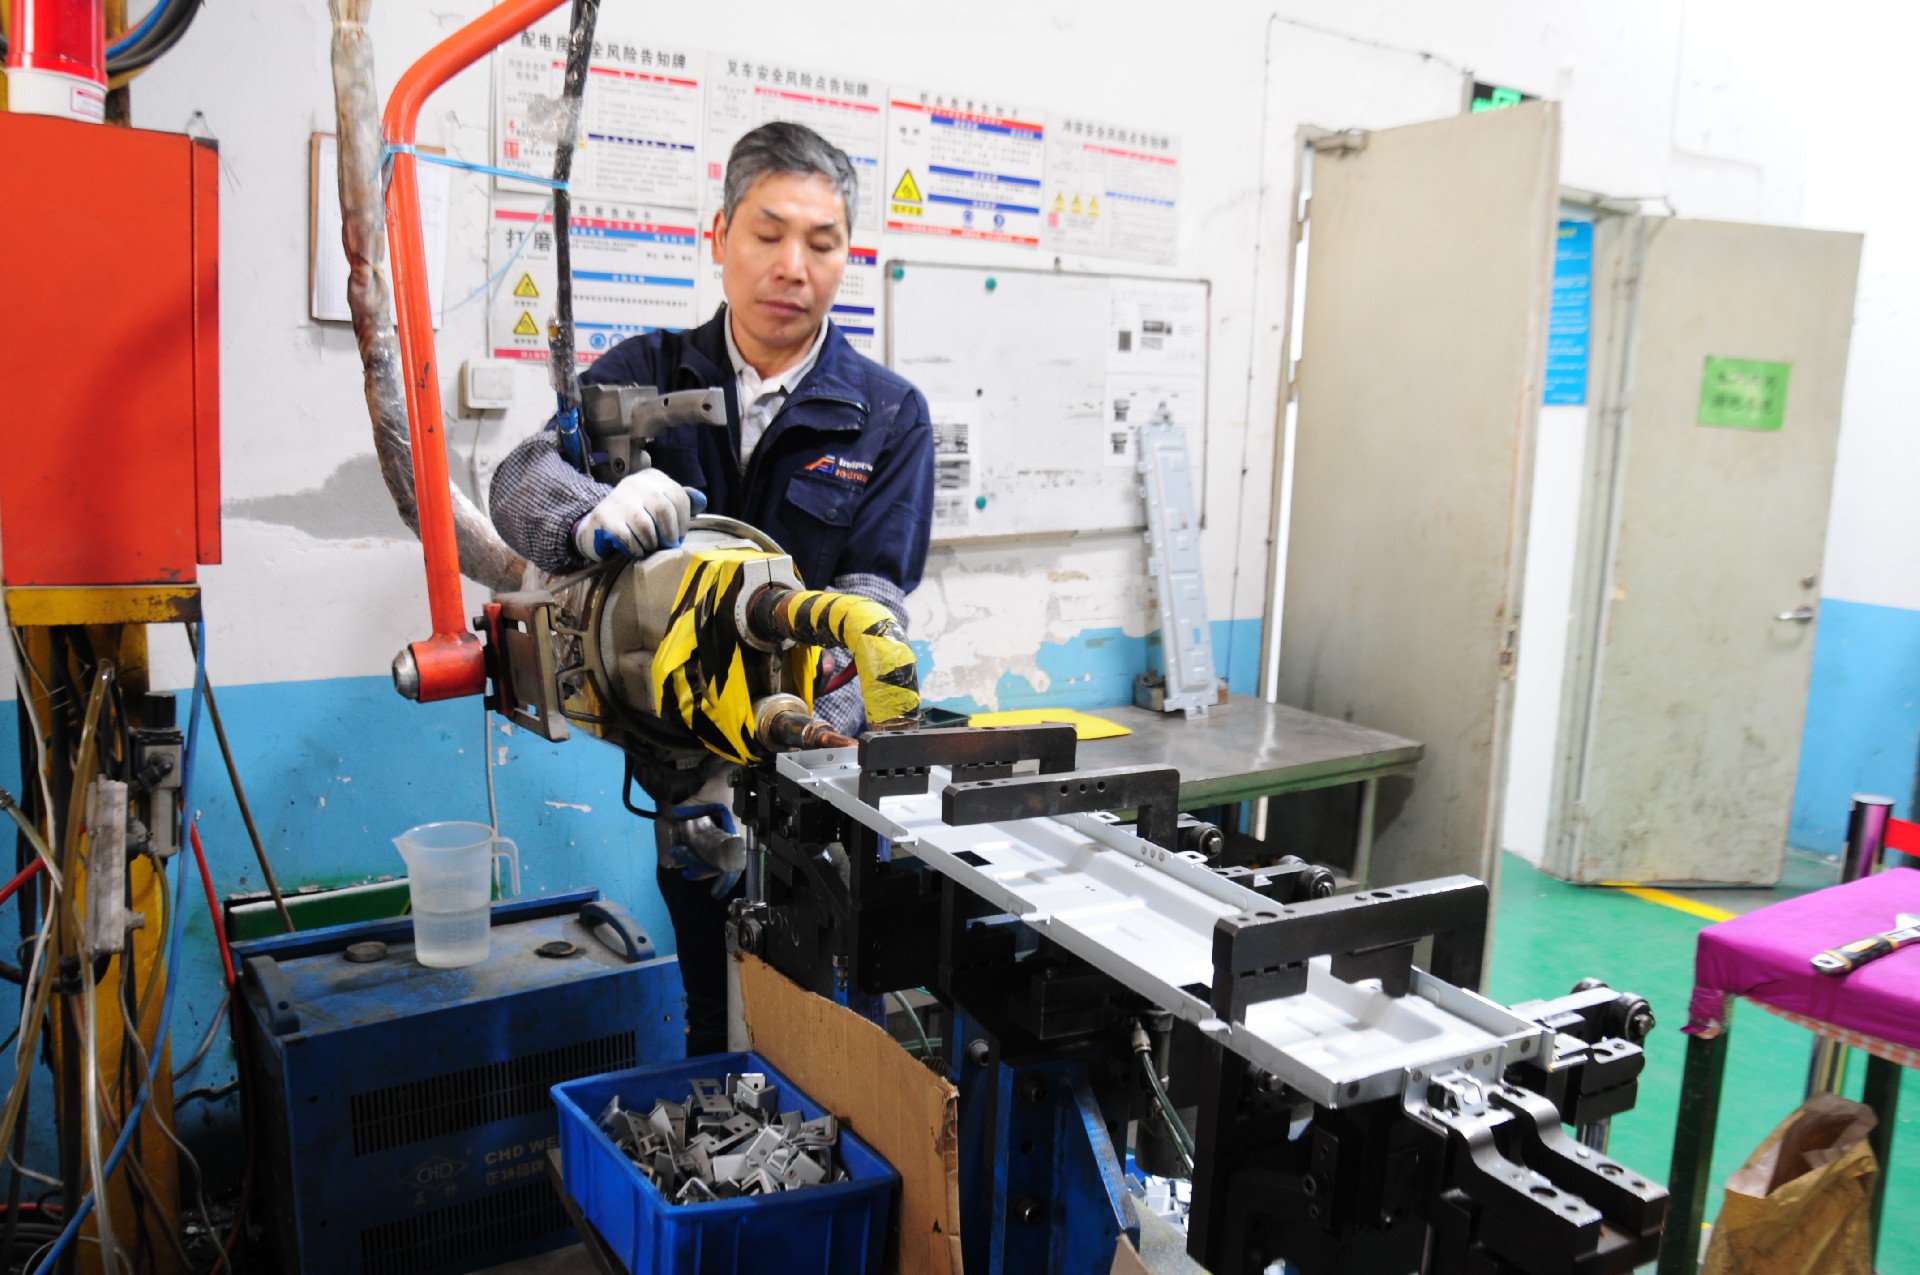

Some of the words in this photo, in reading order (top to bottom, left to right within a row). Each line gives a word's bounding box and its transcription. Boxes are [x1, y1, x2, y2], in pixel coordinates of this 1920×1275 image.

[521, 30, 687, 69] 配电房全风险告知牌
[726, 59, 870, 98] 叉车安全风险点告知牌
[505, 227, 552, 252] 打磨
[484, 1144, 525, 1166] CHD
[529, 1135, 562, 1155] WE
